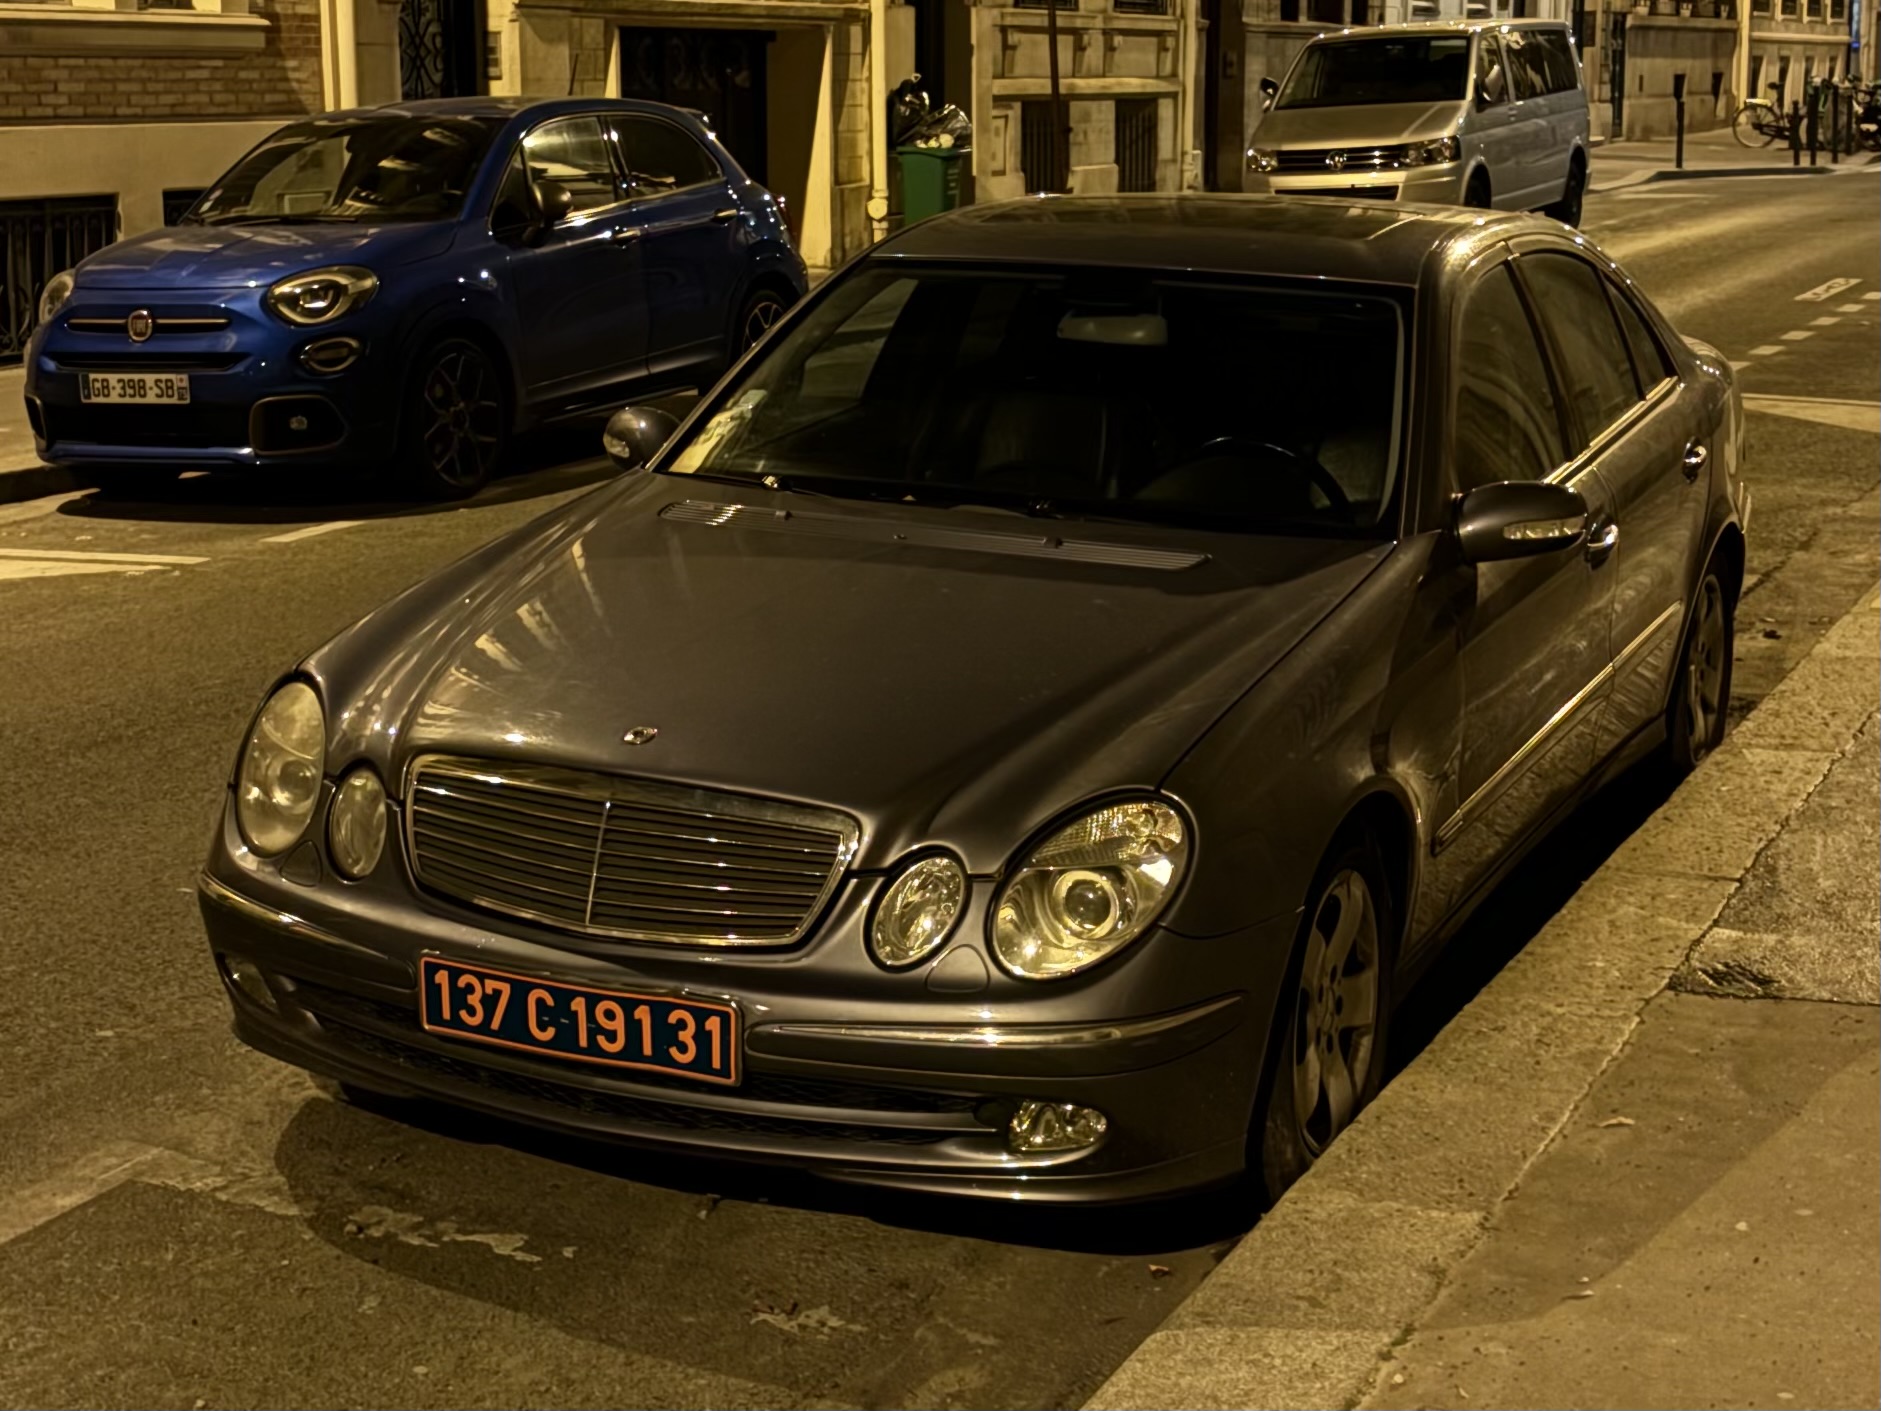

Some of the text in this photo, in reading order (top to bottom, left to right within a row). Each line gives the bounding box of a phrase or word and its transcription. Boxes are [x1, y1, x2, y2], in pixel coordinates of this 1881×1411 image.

[92, 378, 175, 399] GB-398-SB
[434, 969, 511, 1031] 137
[527, 988, 556, 1041] C
